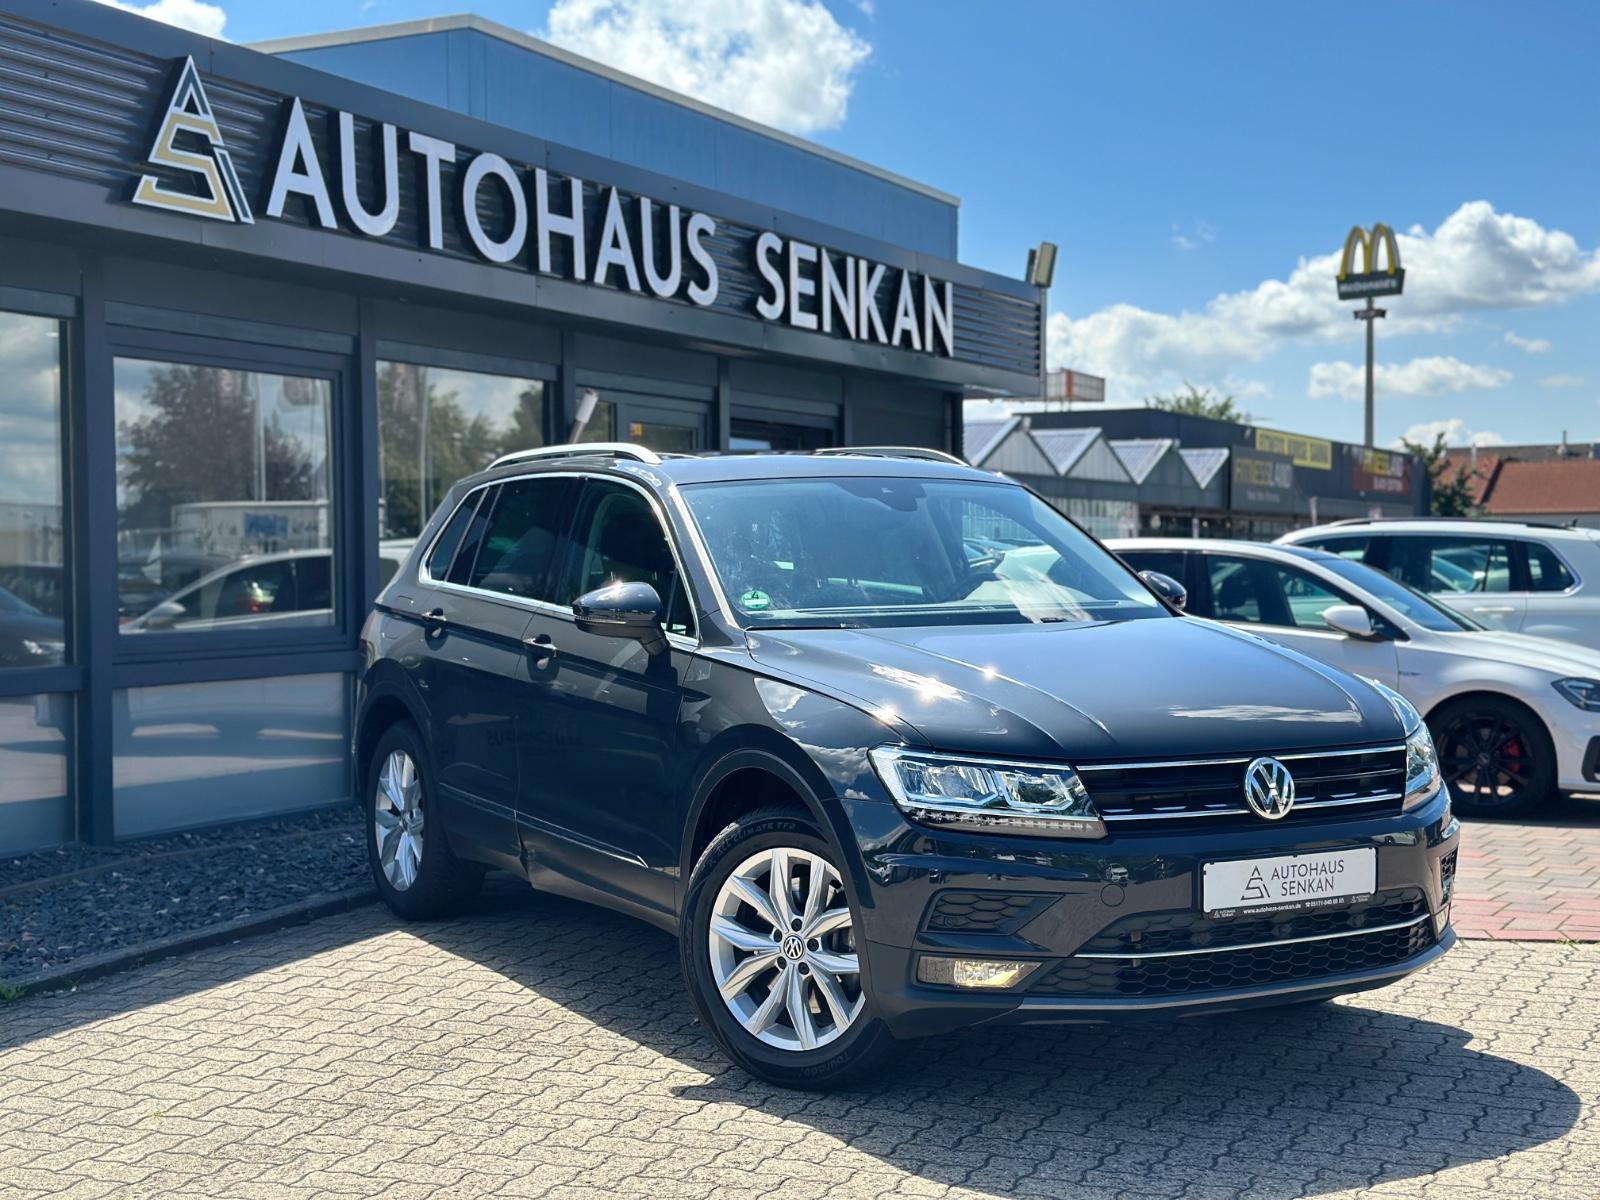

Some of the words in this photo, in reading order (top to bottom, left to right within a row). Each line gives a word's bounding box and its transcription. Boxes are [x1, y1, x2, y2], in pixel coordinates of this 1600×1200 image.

[266, 97, 719, 307] AUTOHAUS
[755, 232, 954, 356] SENKAN
[751, 591, 760, 599] 4
[1271, 859, 1344, 880] AUTOHAUS
[1281, 876, 1334, 896] SENKAN
[1243, 903, 1302, 915] www.autohaus-senkan.de
